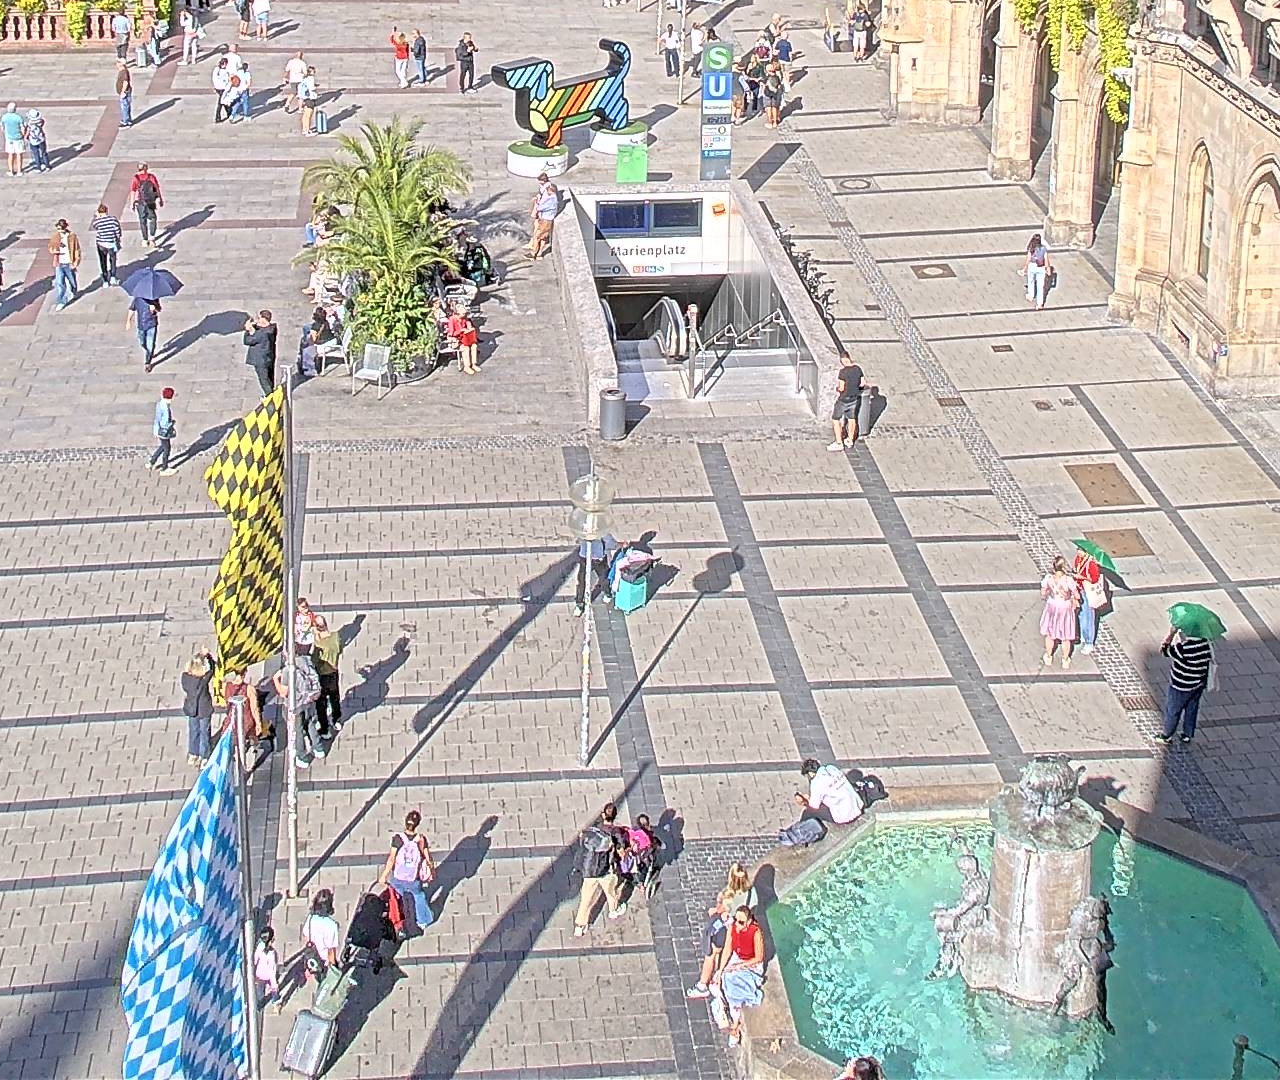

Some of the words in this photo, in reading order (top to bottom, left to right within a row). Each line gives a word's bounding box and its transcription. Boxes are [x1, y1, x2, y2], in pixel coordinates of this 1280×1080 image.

[708, 47, 728, 70] S
[709, 76, 726, 97] U
[610, 243, 686, 257] Marienplatz
